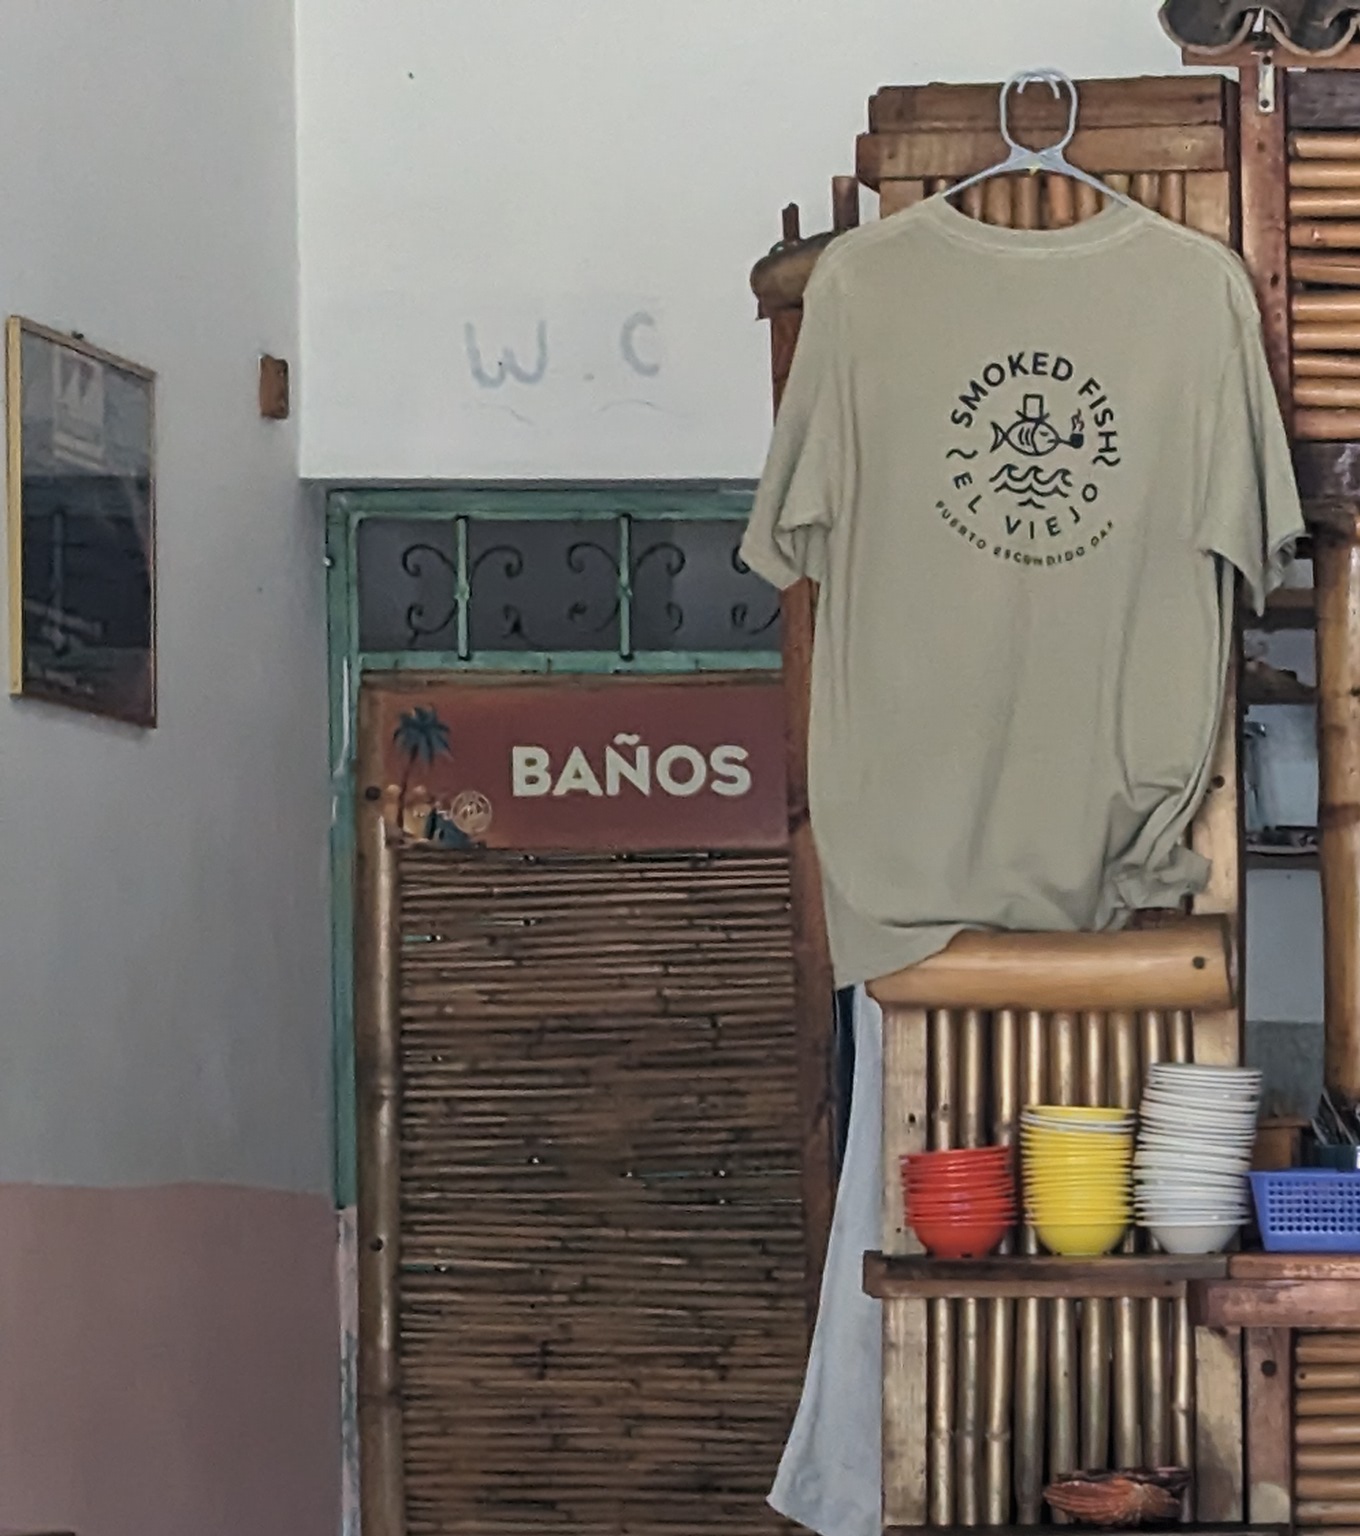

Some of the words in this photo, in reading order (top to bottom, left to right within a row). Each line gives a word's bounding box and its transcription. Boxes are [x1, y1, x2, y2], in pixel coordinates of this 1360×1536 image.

[950, 351, 1074, 429] SMOKED
[1077, 377, 1119, 454] FISH
[935, 500, 987, 550] PUERTO
[993, 546, 1086, 567] ESCONDIDO
[953, 471, 984, 514] EL
[1005, 483, 1098, 540] VIEJO
[511, 733, 752, 798] BAÑOS
